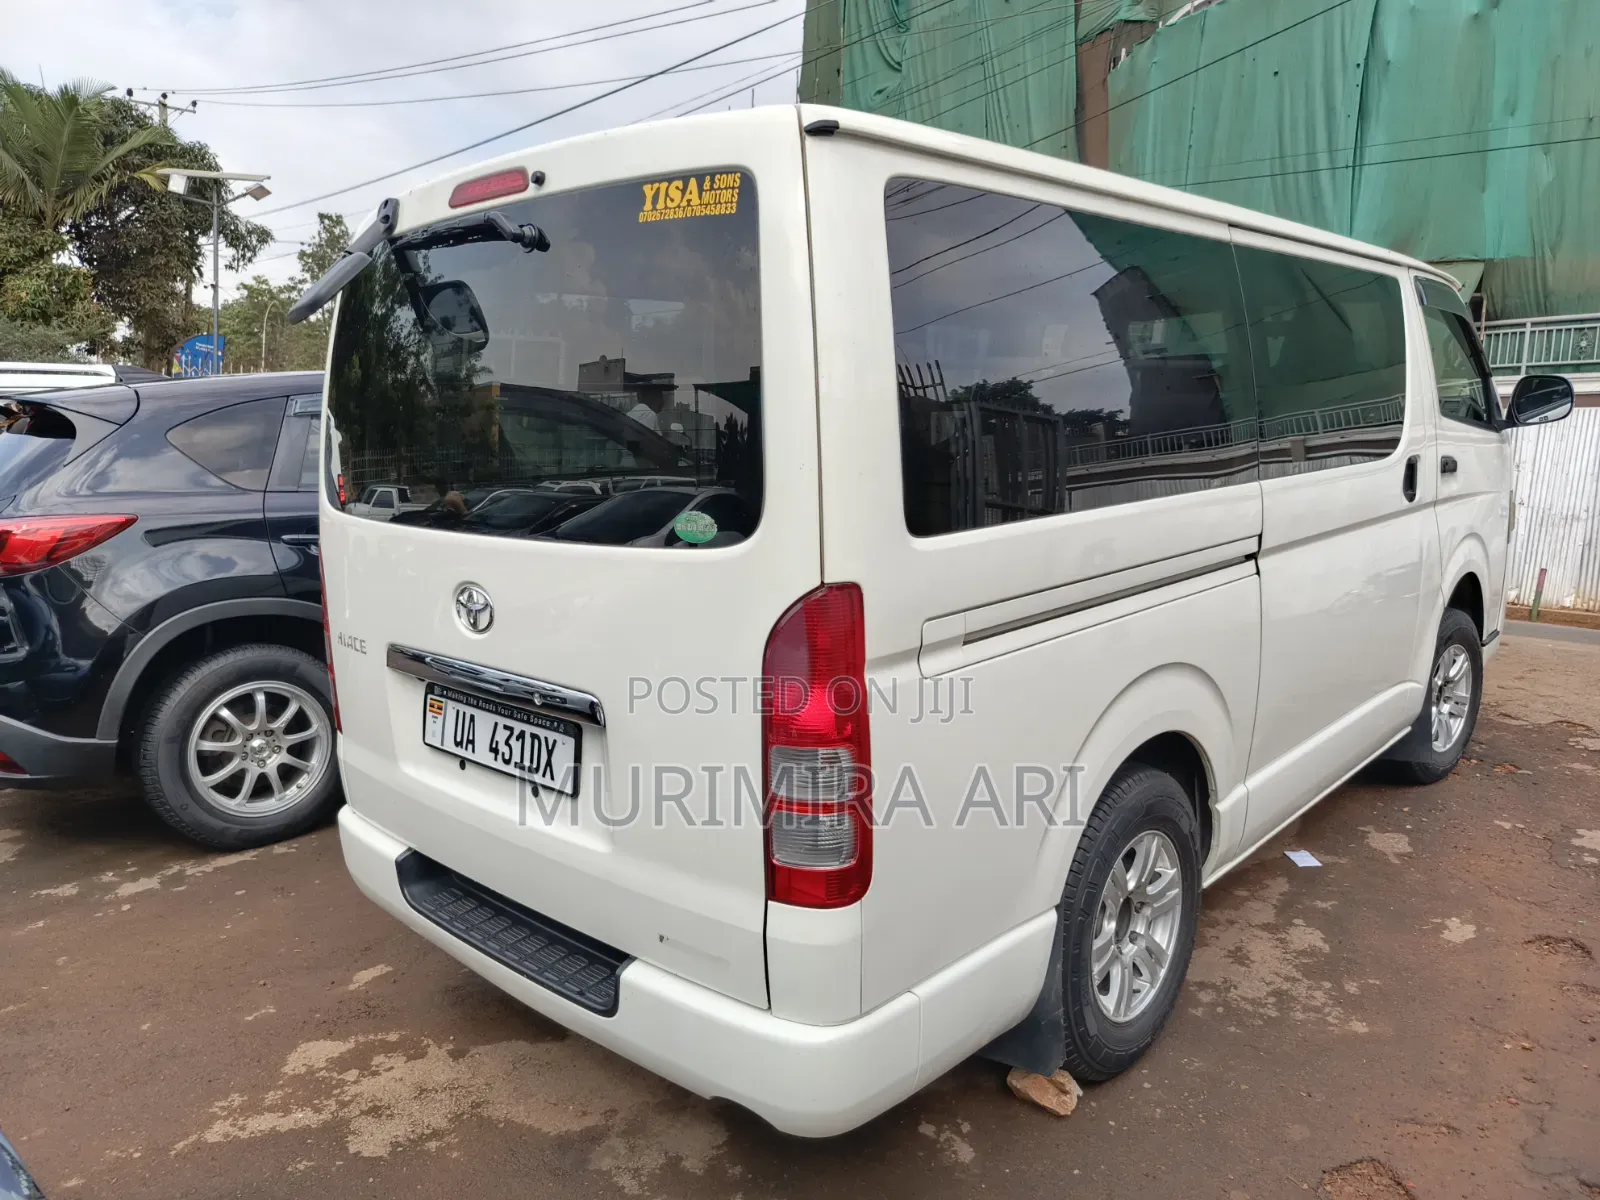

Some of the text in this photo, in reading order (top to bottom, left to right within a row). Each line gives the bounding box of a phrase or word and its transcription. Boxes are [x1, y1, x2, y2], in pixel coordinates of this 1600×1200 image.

[642, 177, 701, 211] YISA
[701, 188, 739, 205] MOTORS
[703, 172, 741, 190] & SONS
[447, 690, 467, 704] Making
[467, 696, 477, 706] the
[478, 700, 496, 711] Roads
[497, 705, 512, 716] Your
[513, 710, 528, 721] Safe
[529, 715, 550, 727] Space
[453, 709, 557, 781] UA 431DX
